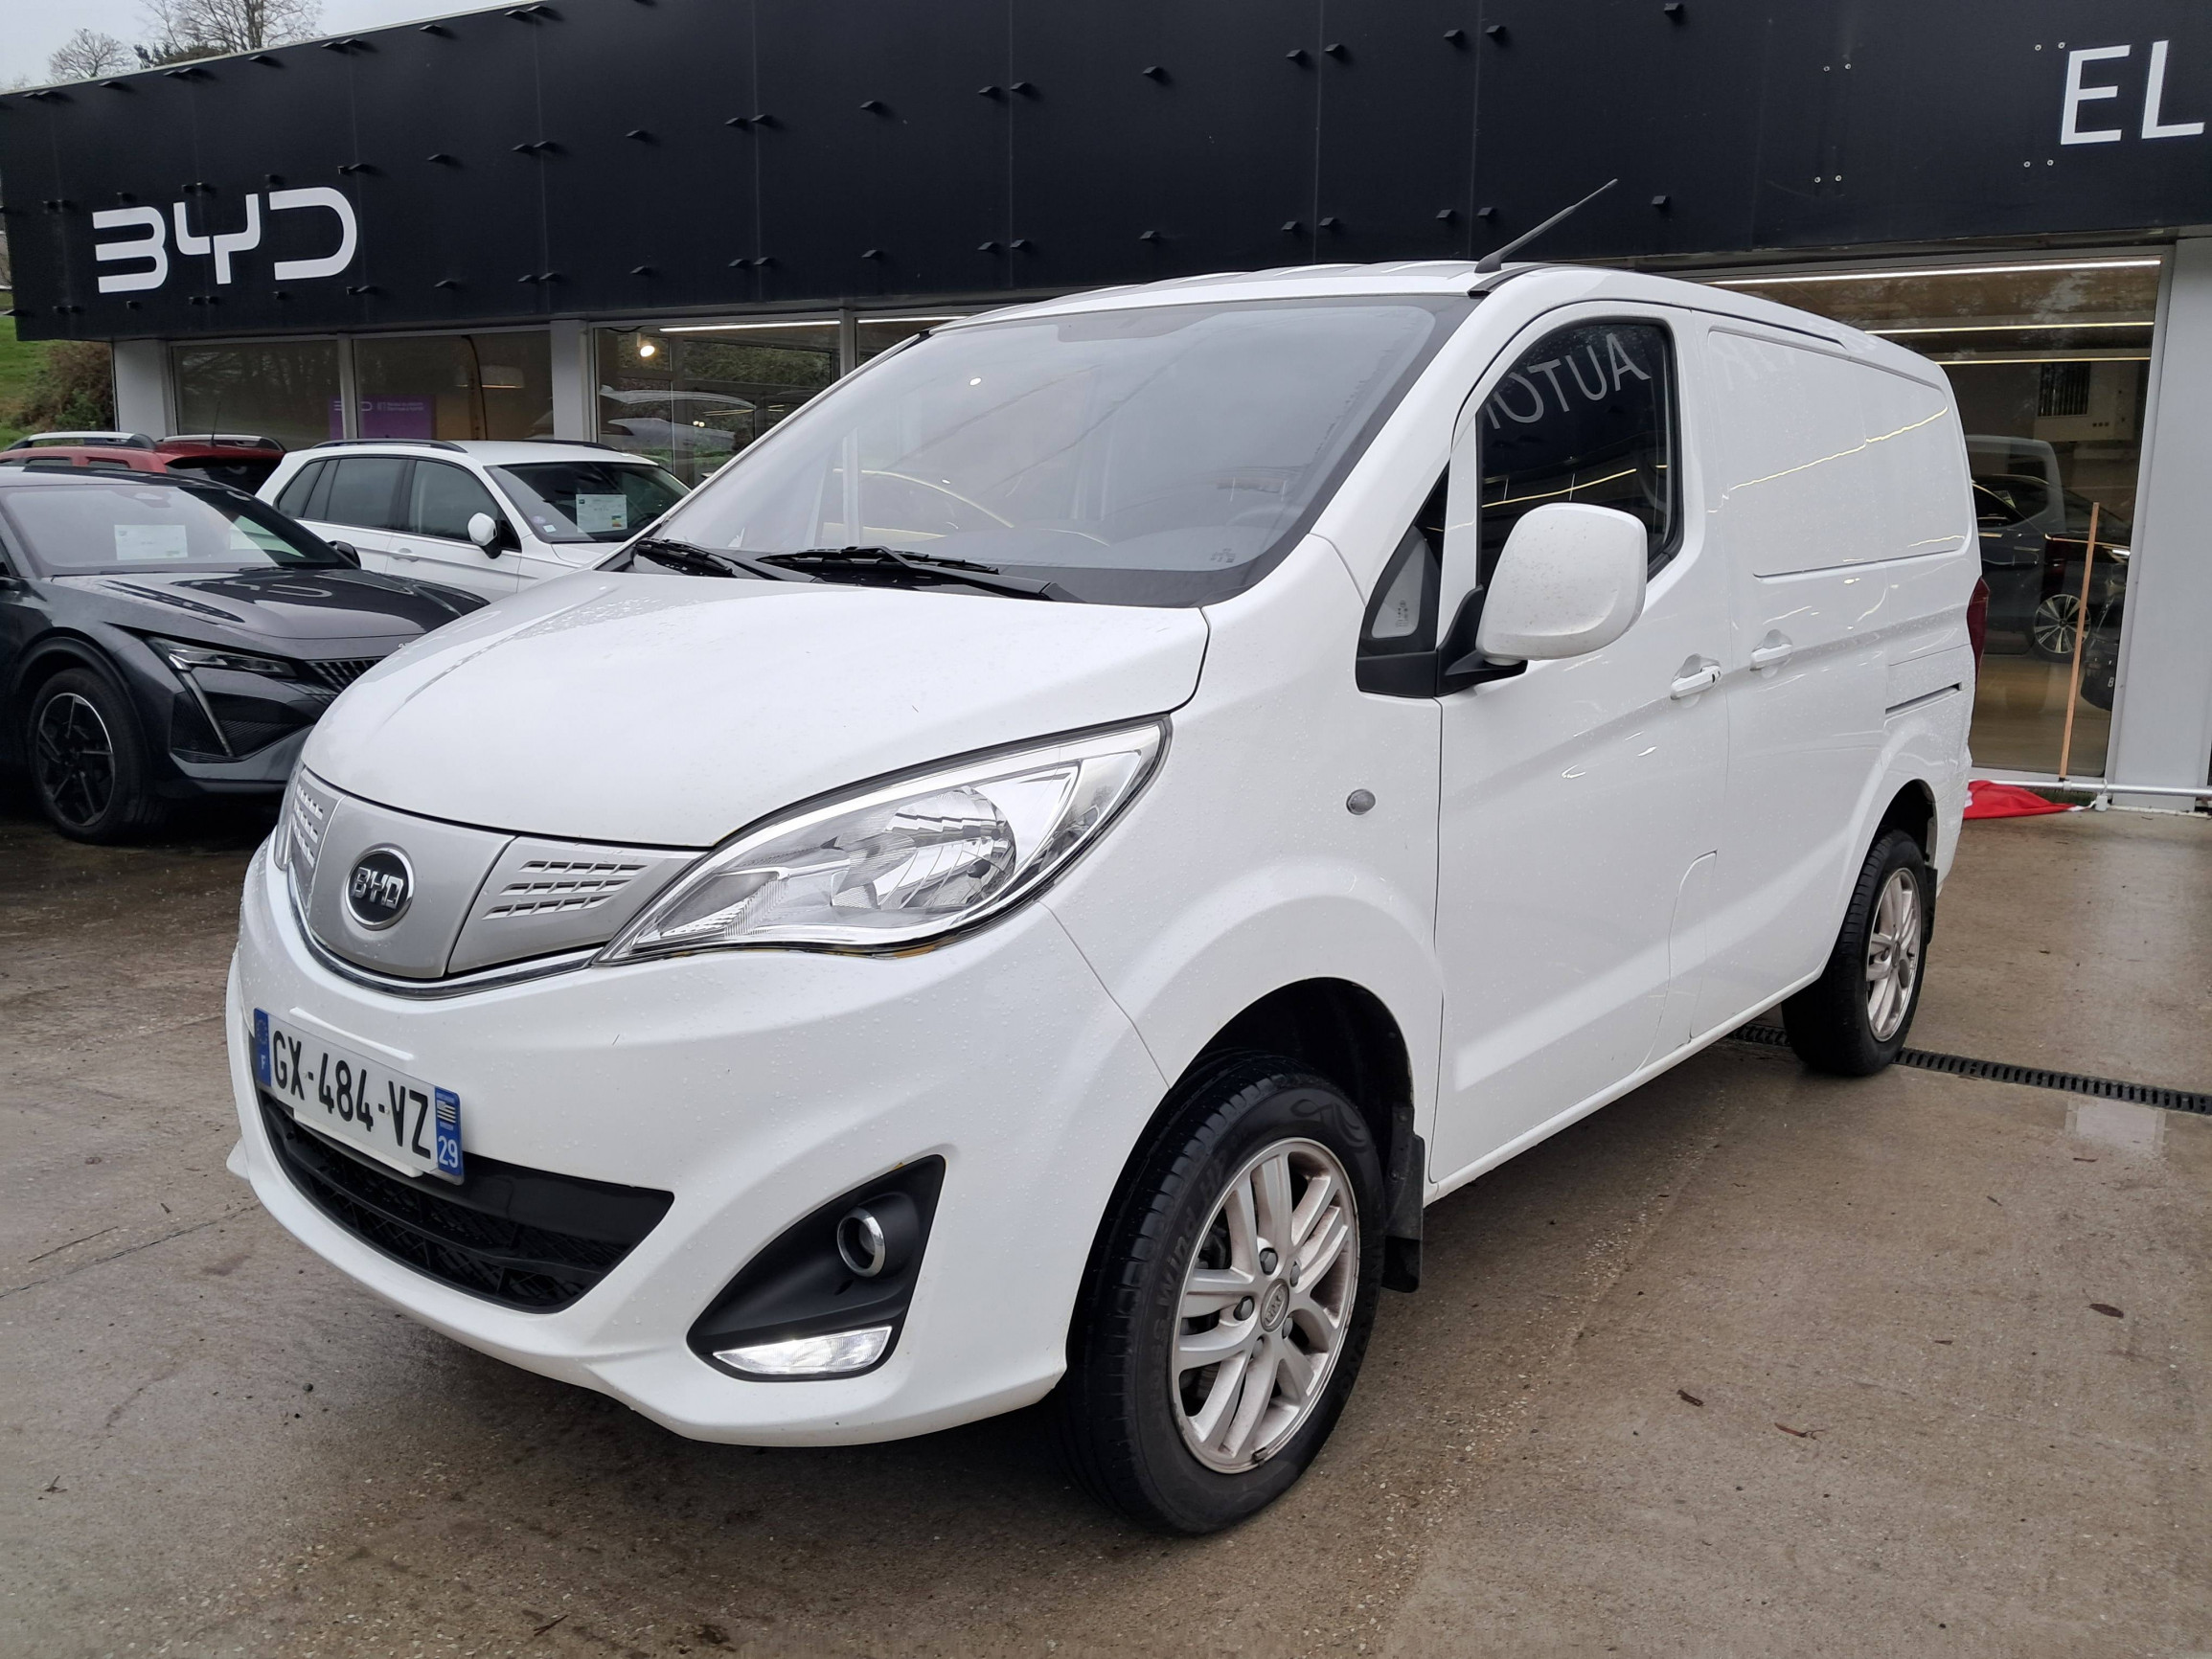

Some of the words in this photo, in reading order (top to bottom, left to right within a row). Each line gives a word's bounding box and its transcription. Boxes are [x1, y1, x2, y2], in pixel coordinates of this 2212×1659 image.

[2061, 40, 2205, 146] EL
[92, 187, 357, 293] BYD
[351, 866, 404, 909] BYD
[260, 1055, 266, 1070] F
[273, 1030, 431, 1160] GX-484-VZ
[438, 1135, 459, 1169] 29
